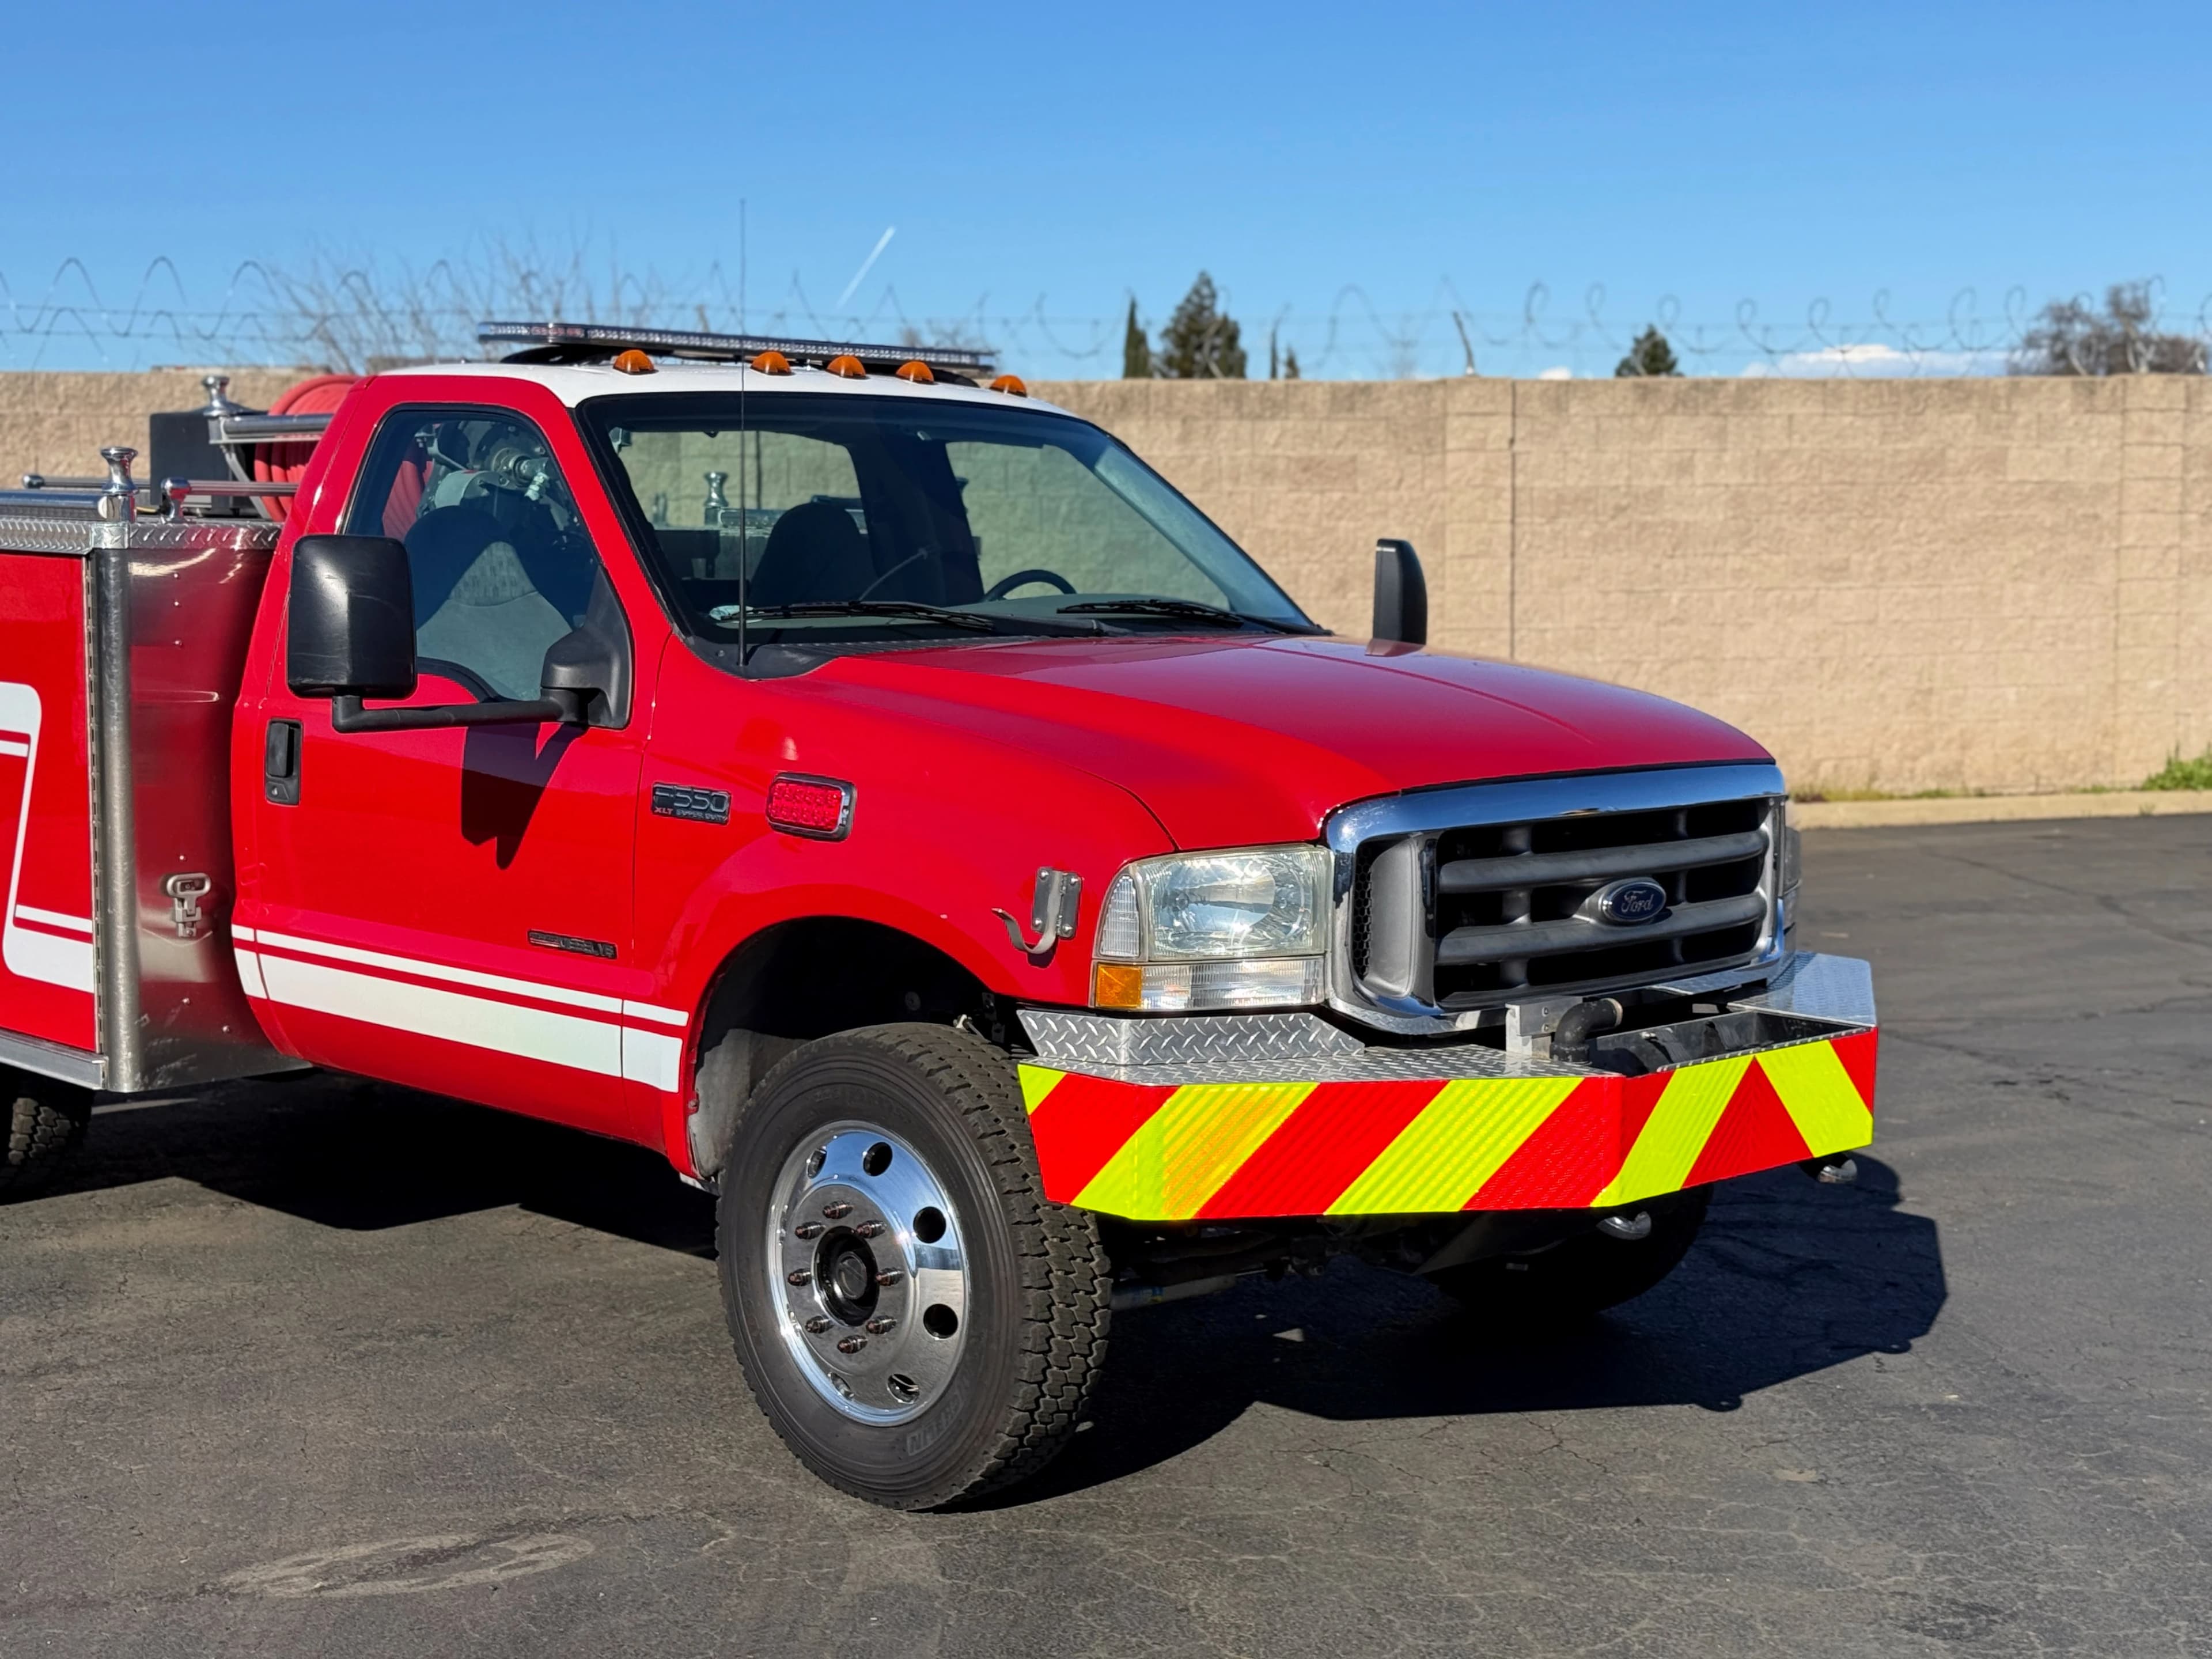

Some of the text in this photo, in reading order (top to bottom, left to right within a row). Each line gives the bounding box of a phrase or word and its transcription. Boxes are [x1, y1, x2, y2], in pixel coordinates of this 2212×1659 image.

[654, 806, 728, 822] XLT SUPER DUTY
[1621, 889, 1655, 914] Ford
